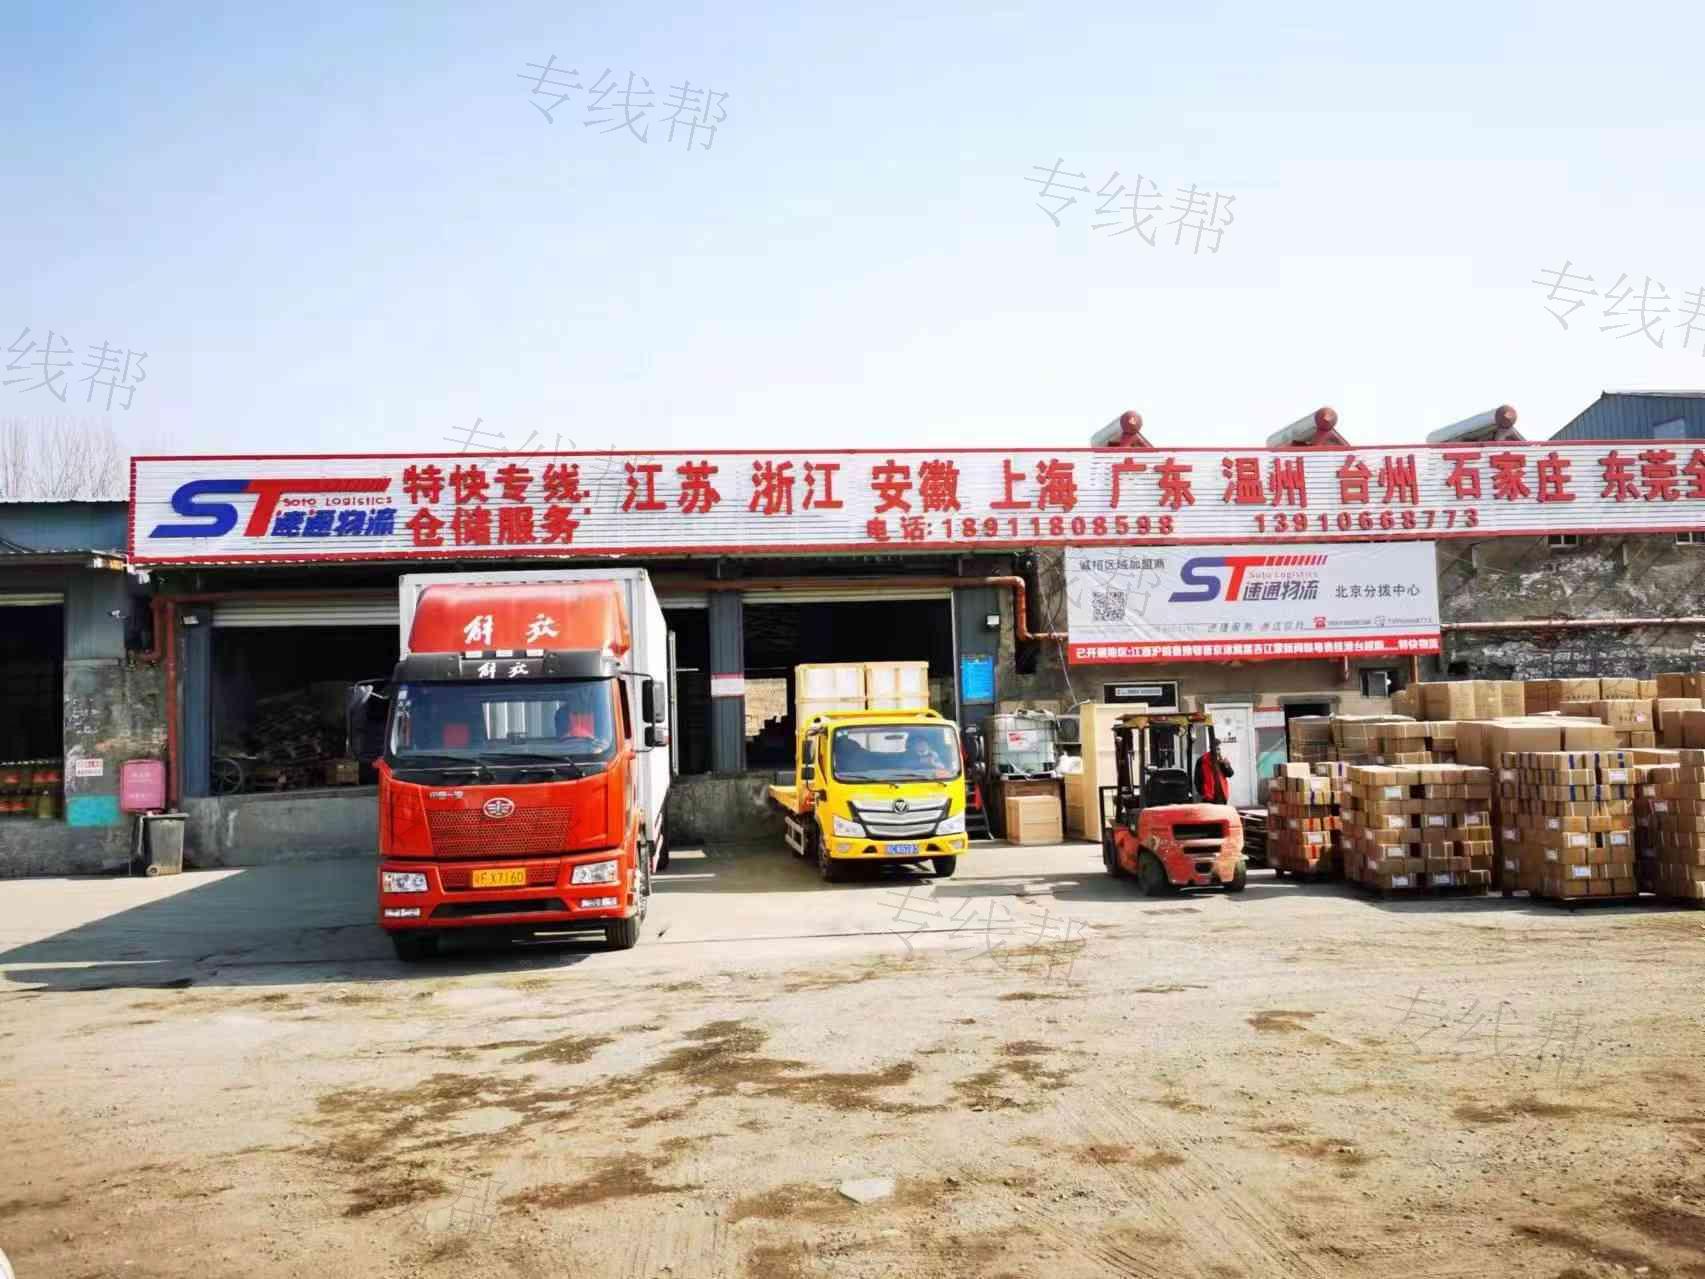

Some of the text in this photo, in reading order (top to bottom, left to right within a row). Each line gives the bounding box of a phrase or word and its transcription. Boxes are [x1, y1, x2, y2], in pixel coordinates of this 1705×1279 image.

[622, 460, 720, 513] 江苏
[749, 460, 844, 514] 浙江
[871, 459, 962, 513] 安徽
[990, 459, 1078, 511] 上海
[1110, 457, 1196, 510] 广东
[1222, 456, 1308, 508] 温州
[1335, 454, 1419, 506] 台州
[1443, 450, 1576, 504] 石家庄
[148, 478, 391, 538] ST
[326, 496, 392, 507] Logistics
[272, 508, 396, 537] 速通物流
[405, 505, 580, 547] 仓储服务
[1253, 508, 1479, 534] 13910668773
[1168, 554, 1327, 602] ST
[1243, 579, 1319, 601] 速通物流
[1335, 583, 1421, 599] 北京分拨中心
[463, 613, 560, 645] 解放
[477, 662, 528, 679] 解放
